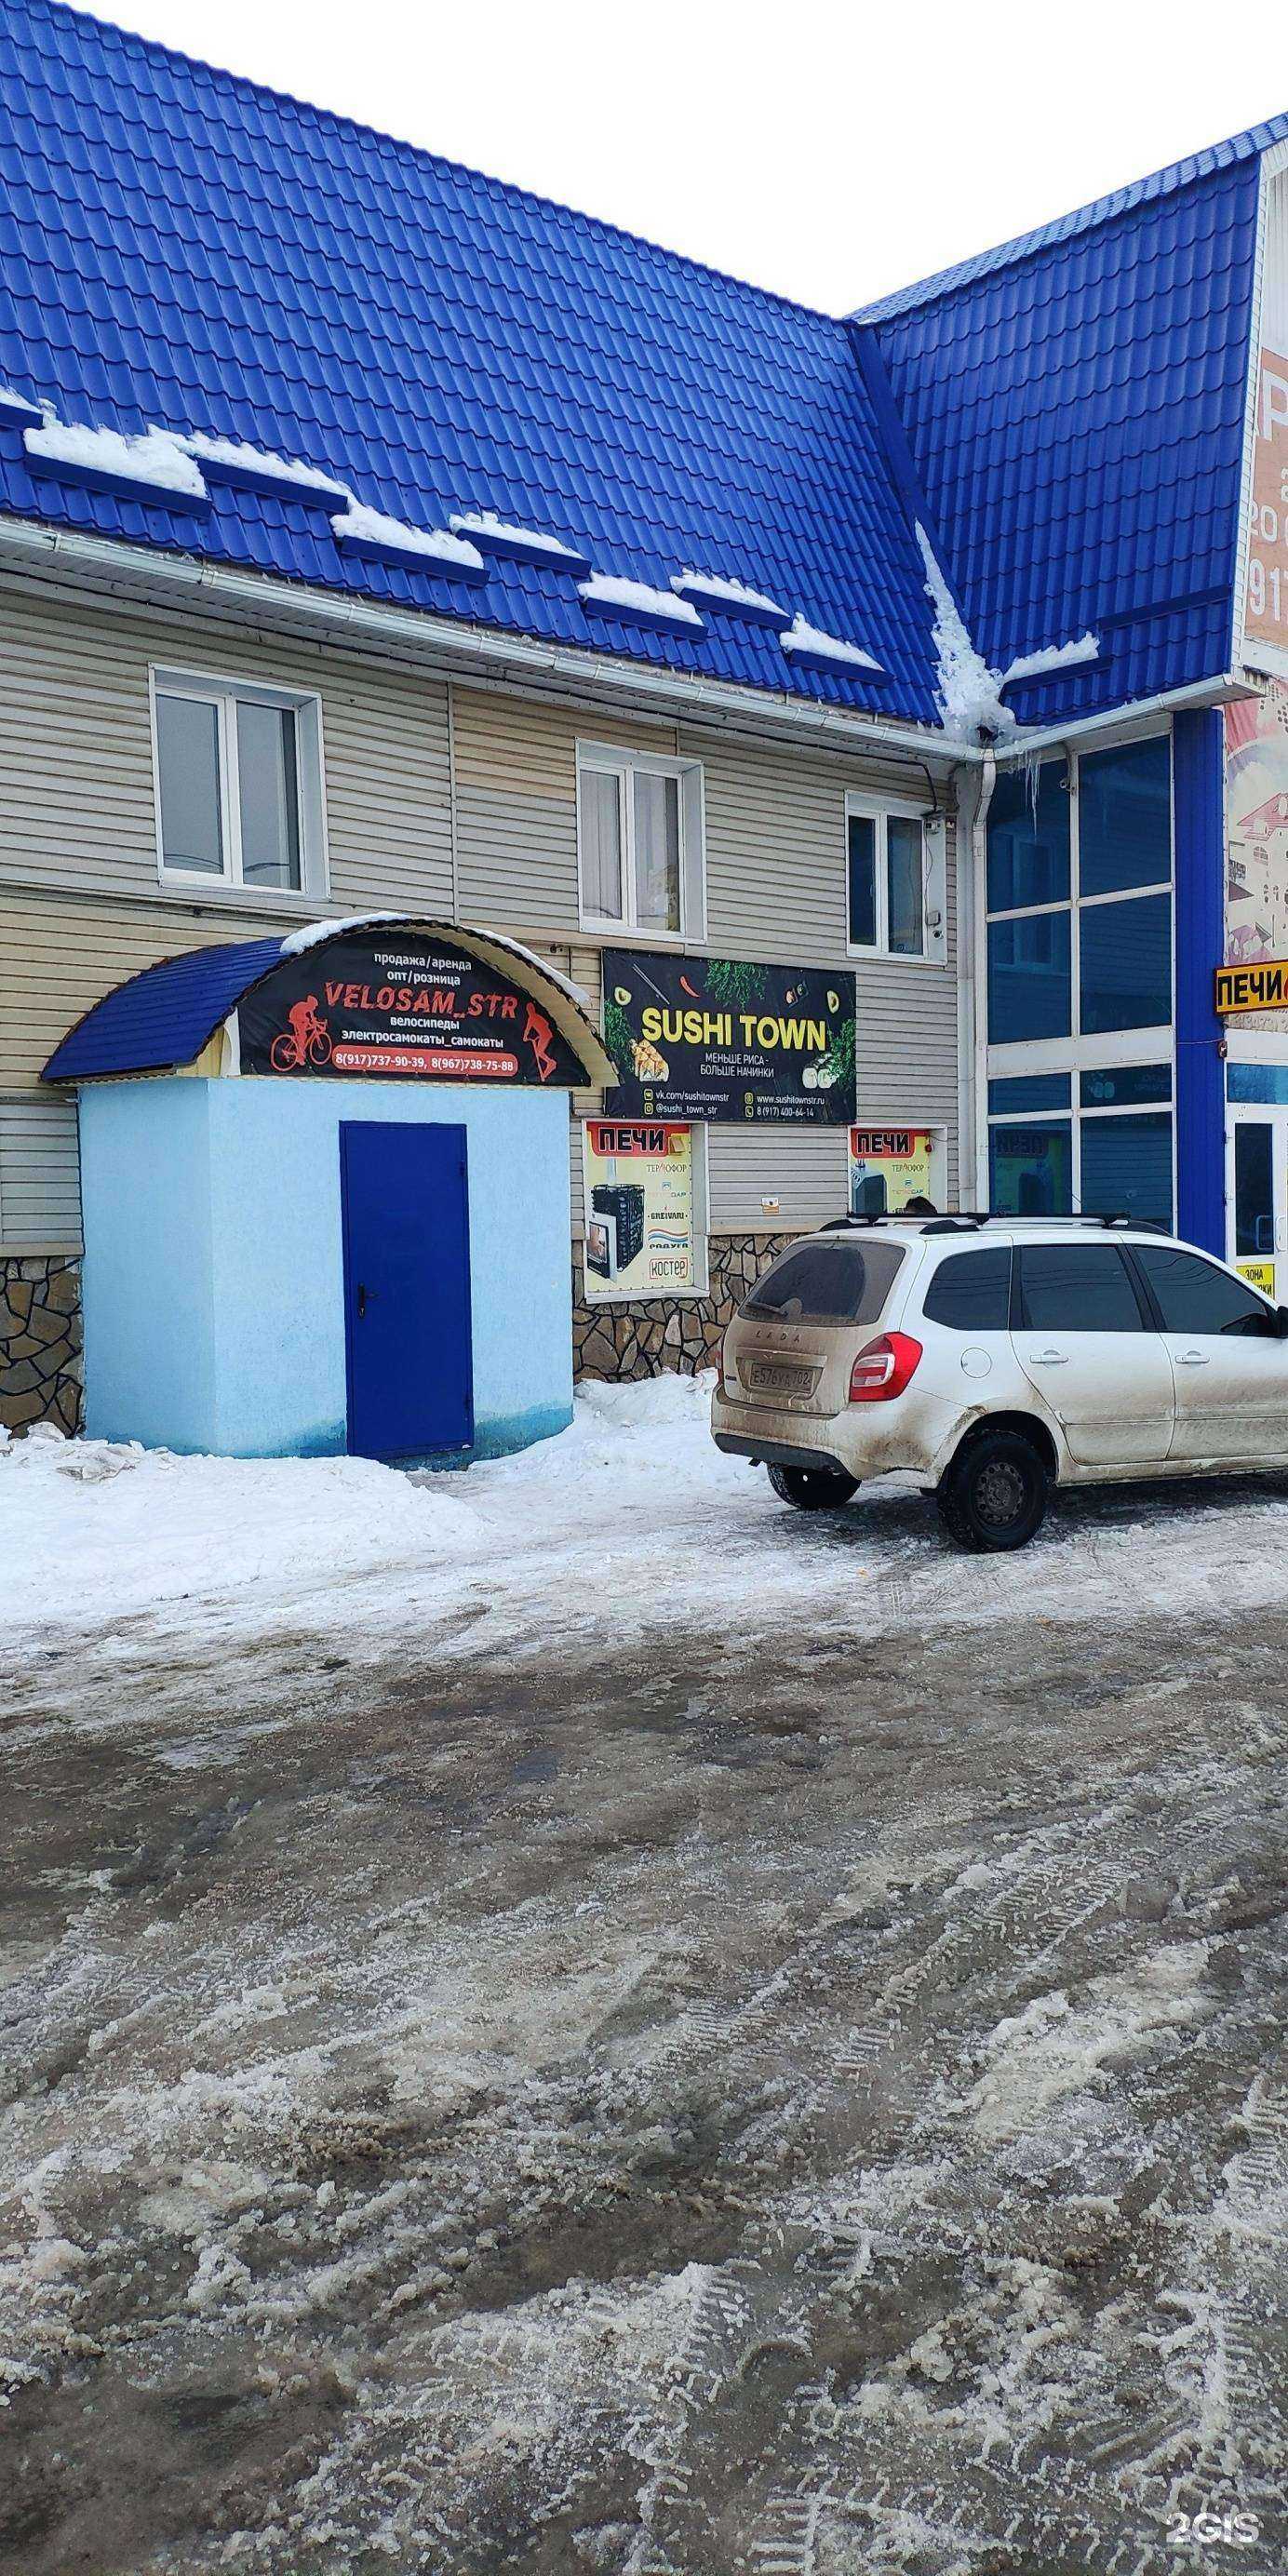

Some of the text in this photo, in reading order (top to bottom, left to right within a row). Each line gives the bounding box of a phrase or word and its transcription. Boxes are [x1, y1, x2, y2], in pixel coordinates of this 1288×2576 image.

[374, 953, 472, 972] продажа/аренда
[387, 970, 461, 986] опт/розница
[1217, 970, 1282, 1006] ПЕЧИ
[324, 981, 518, 1019] VELOSAM_STR
[390, 1015, 461, 1030] велосипеды
[642, 1007, 825, 1051] SUSHI TOWN
[341, 1029, 504, 1049] электросамокаты_самокаты
[705, 1052, 742, 1065] МЕНЬШЕ
[743, 1053, 765, 1066] РИСА
[700, 1064, 774, 1078] БОЛЬШЕ НАЧИНКИ
[655, 1090, 730, 1102] vk.com/sushitownstr
[757, 1094, 825, 1106] www.sushitownstr.ru
[655, 1103, 718, 1115] @sushi_town_str
[757, 1106, 762, 1116] 8
[598, 1128, 665, 1152] ПЕЧИ
[856, 1132, 910, 1154] ПЕЧИ
[1245, 1268, 1264, 1281] ЗОНА
[756, 1330, 801, 1343] LADA
